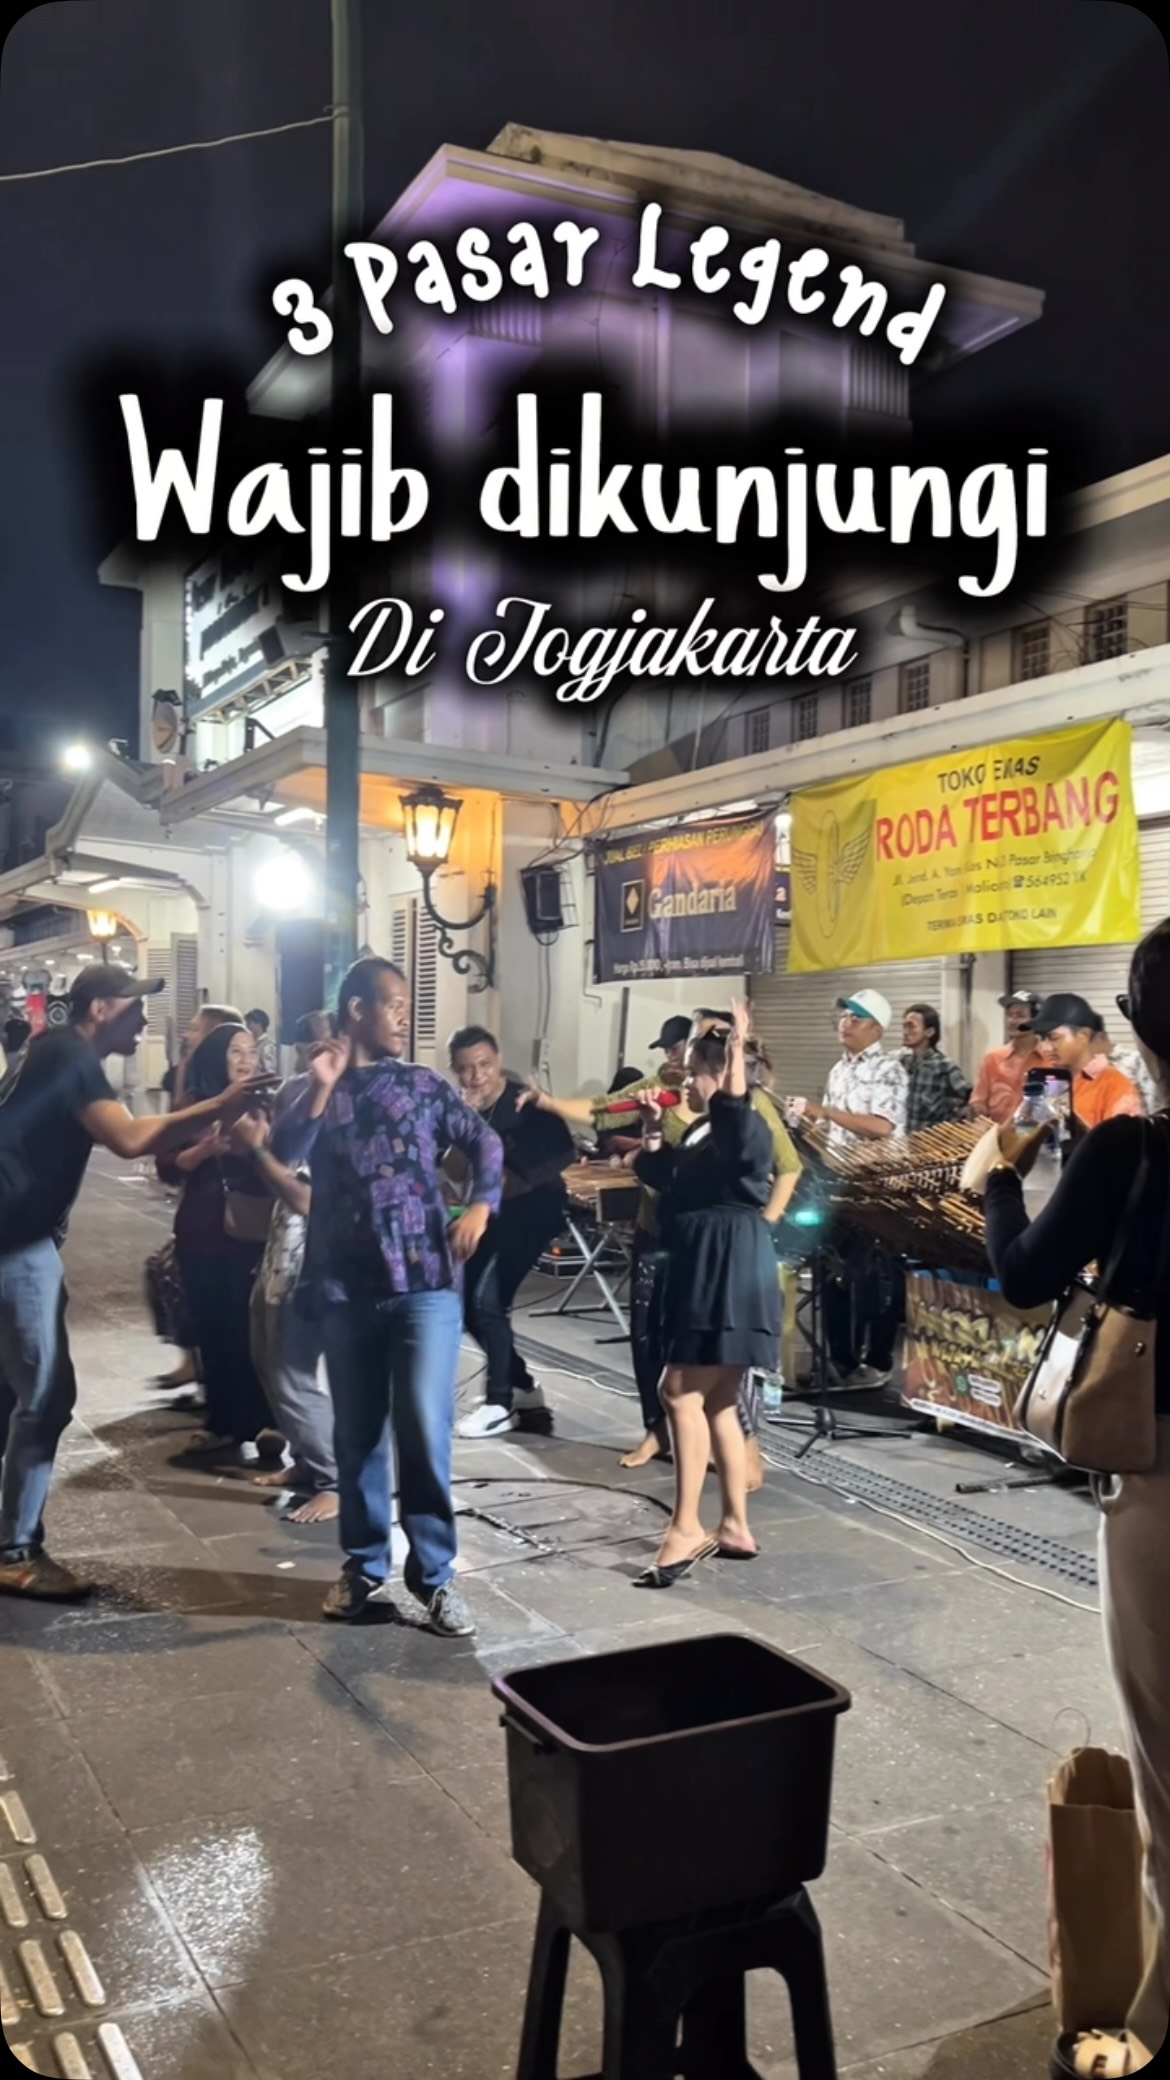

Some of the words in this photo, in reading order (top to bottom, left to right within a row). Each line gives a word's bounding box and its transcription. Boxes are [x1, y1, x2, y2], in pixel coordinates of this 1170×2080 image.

[938, 763, 986, 793] TOKO
[994, 755, 1041, 781] EMAS
[876, 804, 957, 863] RODA
[963, 769, 1120, 844] TERBANG
[649, 880, 737, 919] Gandaria
